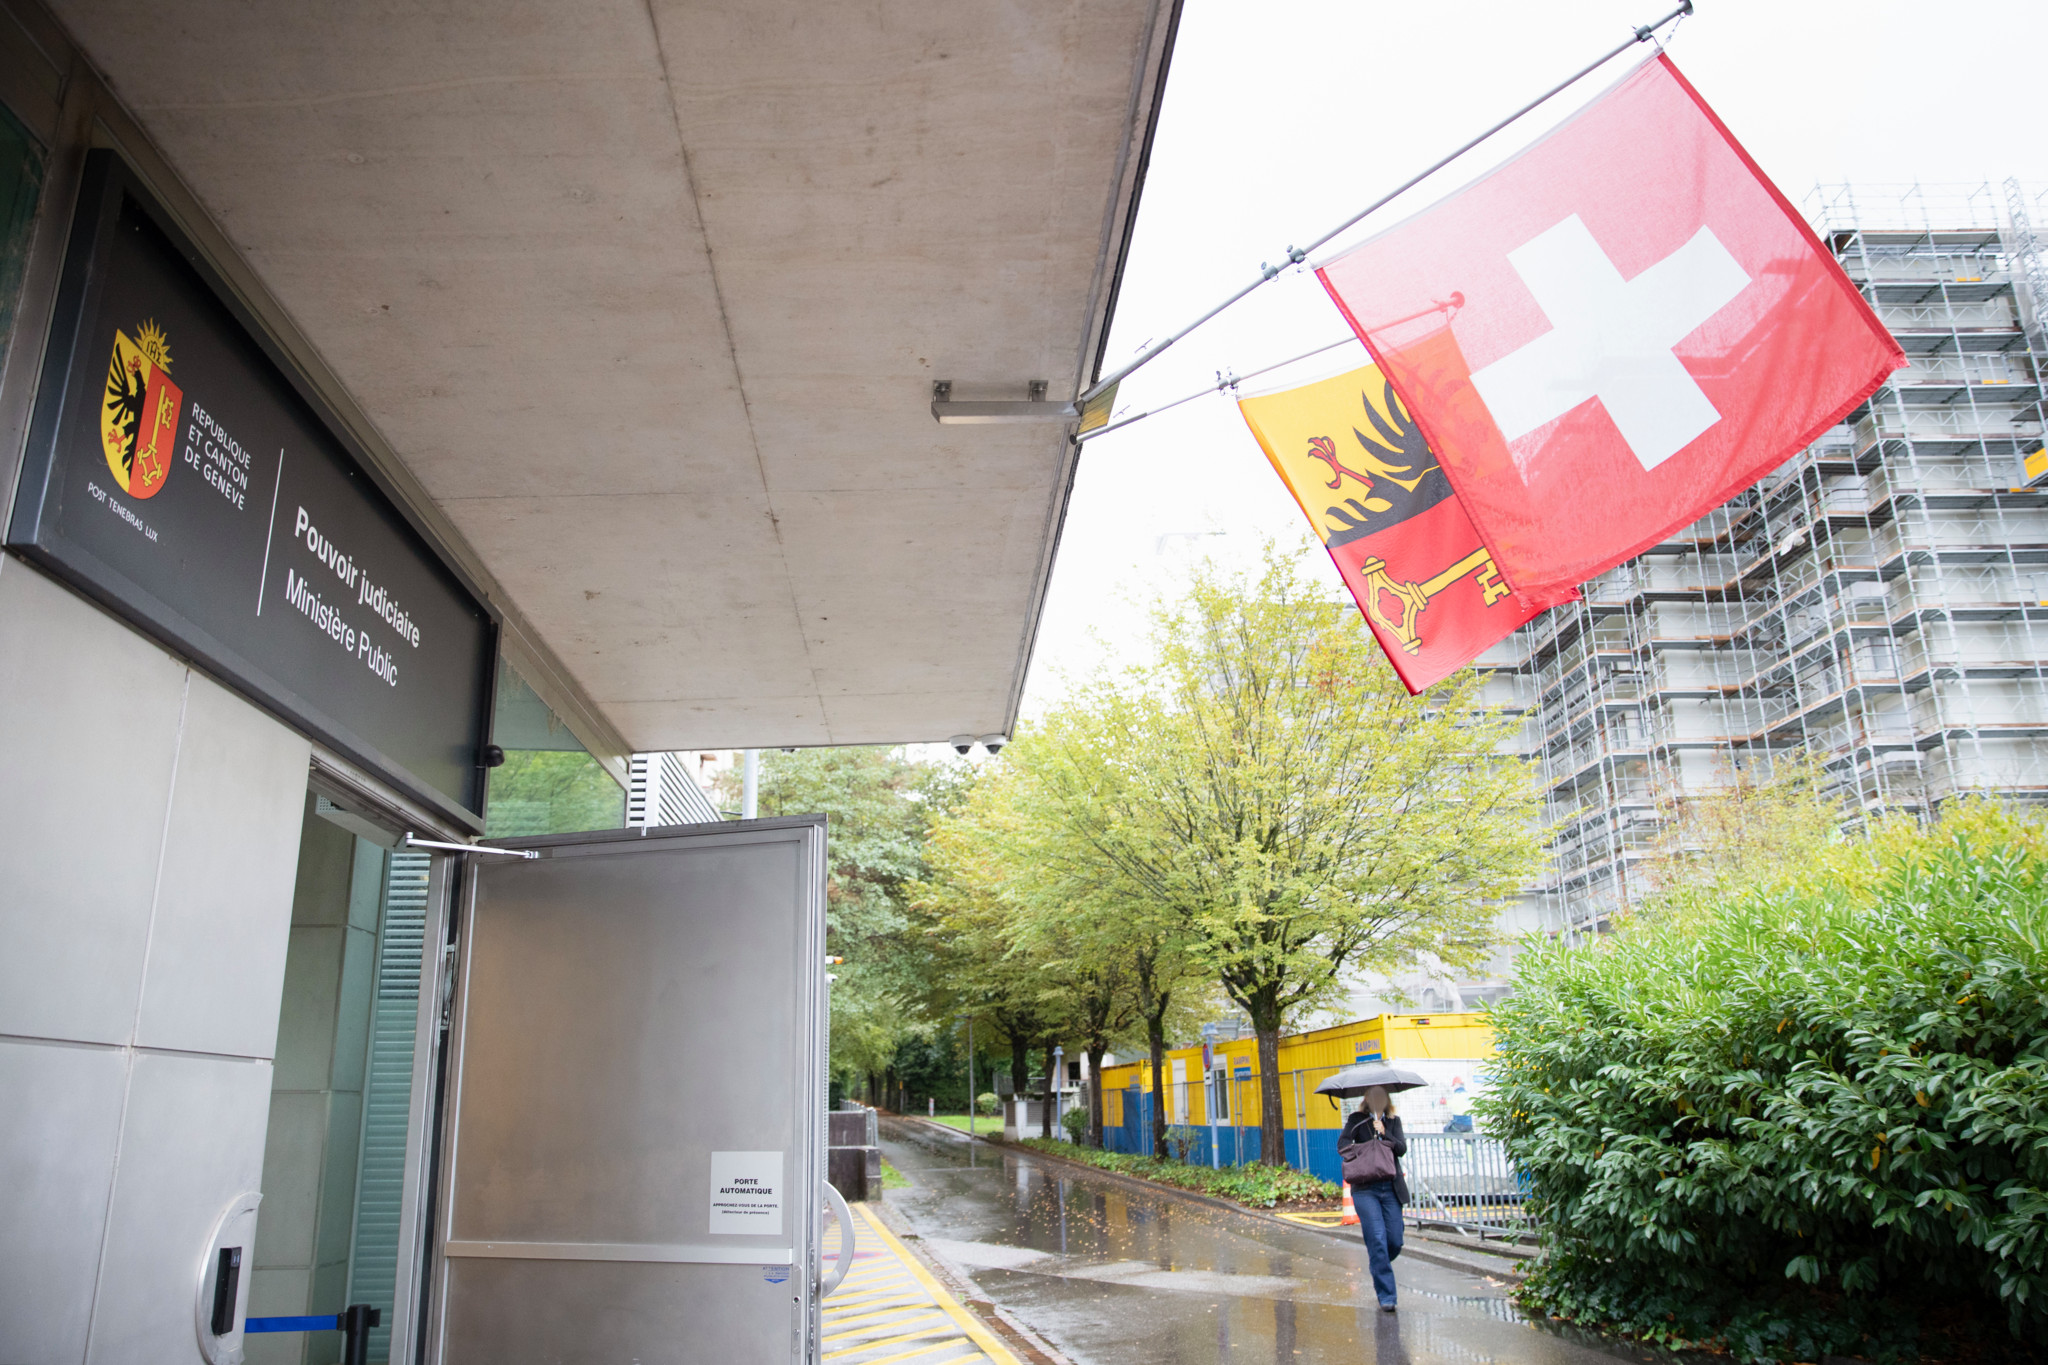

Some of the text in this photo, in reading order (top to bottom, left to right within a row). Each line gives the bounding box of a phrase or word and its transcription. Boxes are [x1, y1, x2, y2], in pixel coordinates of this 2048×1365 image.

[188, 424, 248, 491] ET CANTON
[191, 402, 251, 470] REPUBLIQUE
[184, 446, 245, 511] DE GENEVE
[87, 481, 158, 543] POST TENEBRAS LUX
[294, 505, 420, 648] Pouvoir judiciaire
[285, 567, 398, 687] Ministère Public
[1355, 1039, 1380, 1053] RAMPINI
[720, 1187, 773, 1195] AUTOMATIQUE
